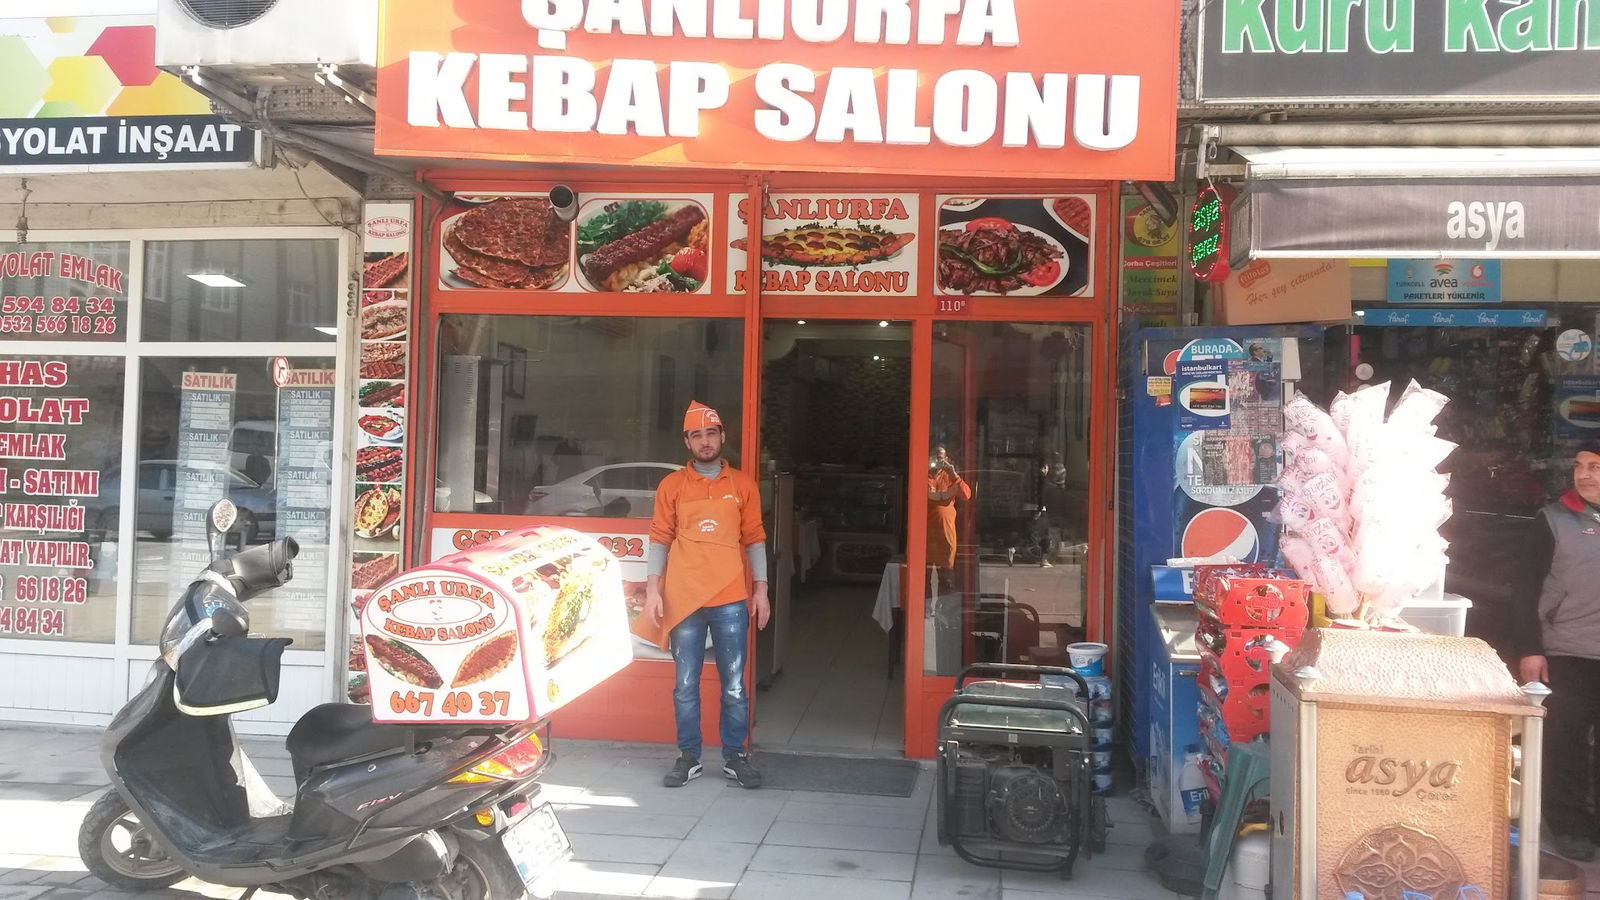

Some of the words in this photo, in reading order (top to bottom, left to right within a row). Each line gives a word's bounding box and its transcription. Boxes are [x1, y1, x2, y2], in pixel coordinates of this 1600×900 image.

[407, 50, 731, 138] KEBAP
[754, 62, 1140, 151] SALONU
[0, 126, 107, 155] YOLAT
[118, 119, 241, 159] İNŞAAT
[1447, 201, 1525, 250] asya
[60, 252, 123, 294] EMLAK
[734, 270, 812, 292] KBAP
[815, 270, 909, 292] SALONU
[1430, 278, 1458, 288] avea
[2, 296, 45, 313] 594
[51, 297, 79, 313] 84
[85, 297, 115, 315] 34
[36, 316, 67, 333] 566
[71, 316, 91, 333] 18
[94, 316, 116, 335] 26
[1191, 344, 1233, 354] BURADA
[183, 374, 235, 389] SATILIK
[288, 371, 334, 385] ATILIK
[191, 393, 221, 402] SATILIK
[290, 390, 321, 399] SATILIK
[189, 432, 219, 441] SATILIK
[290, 430, 320, 439] SATILIK
[23, 468, 100, 497] SATIMI
[4, 499, 85, 535] KARŞILIĞI
[26, 540, 94, 569] YAPILIR.
[16, 575, 37, 601] 66
[41, 576, 60, 603] 18
[62, 577, 87, 604] 26
[377, 581, 436, 613] ŞANLI
[440, 581, 495, 610] URFA
[15, 607, 38, 634] 84
[41, 609, 64, 636] 34
[384, 618, 436, 641] KEBAP
[438, 613, 496, 641] SALONU
[390, 691, 435, 717] 667
[441, 691, 473, 717] 40
[478, 691, 511, 717] 37
[1345, 756, 1462, 797] asya
